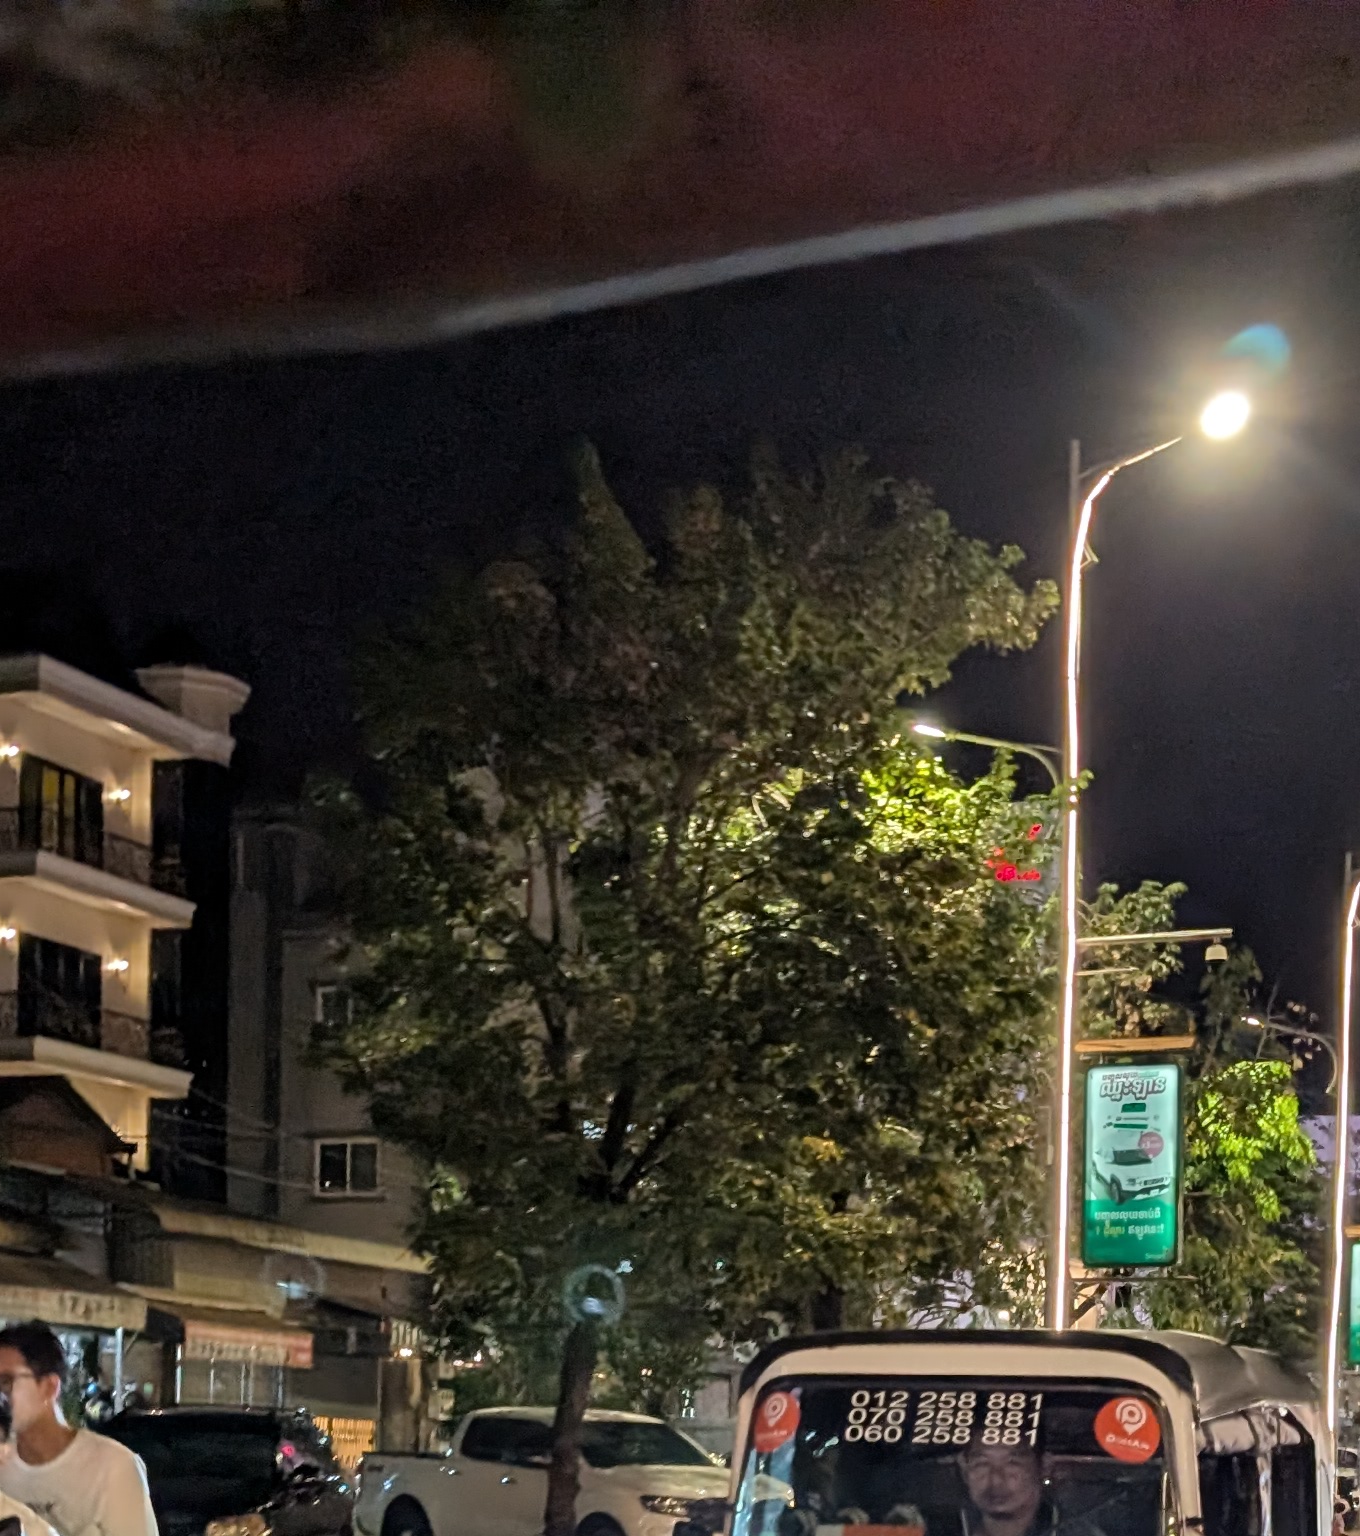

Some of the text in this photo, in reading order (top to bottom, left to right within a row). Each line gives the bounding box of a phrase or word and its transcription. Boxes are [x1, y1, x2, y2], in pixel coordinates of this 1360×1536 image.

[851, 1390, 1044, 1410] 012 258 881
[848, 1407, 1040, 1428] 070 258 881
[844, 1424, 1039, 1447] 060 258 881
